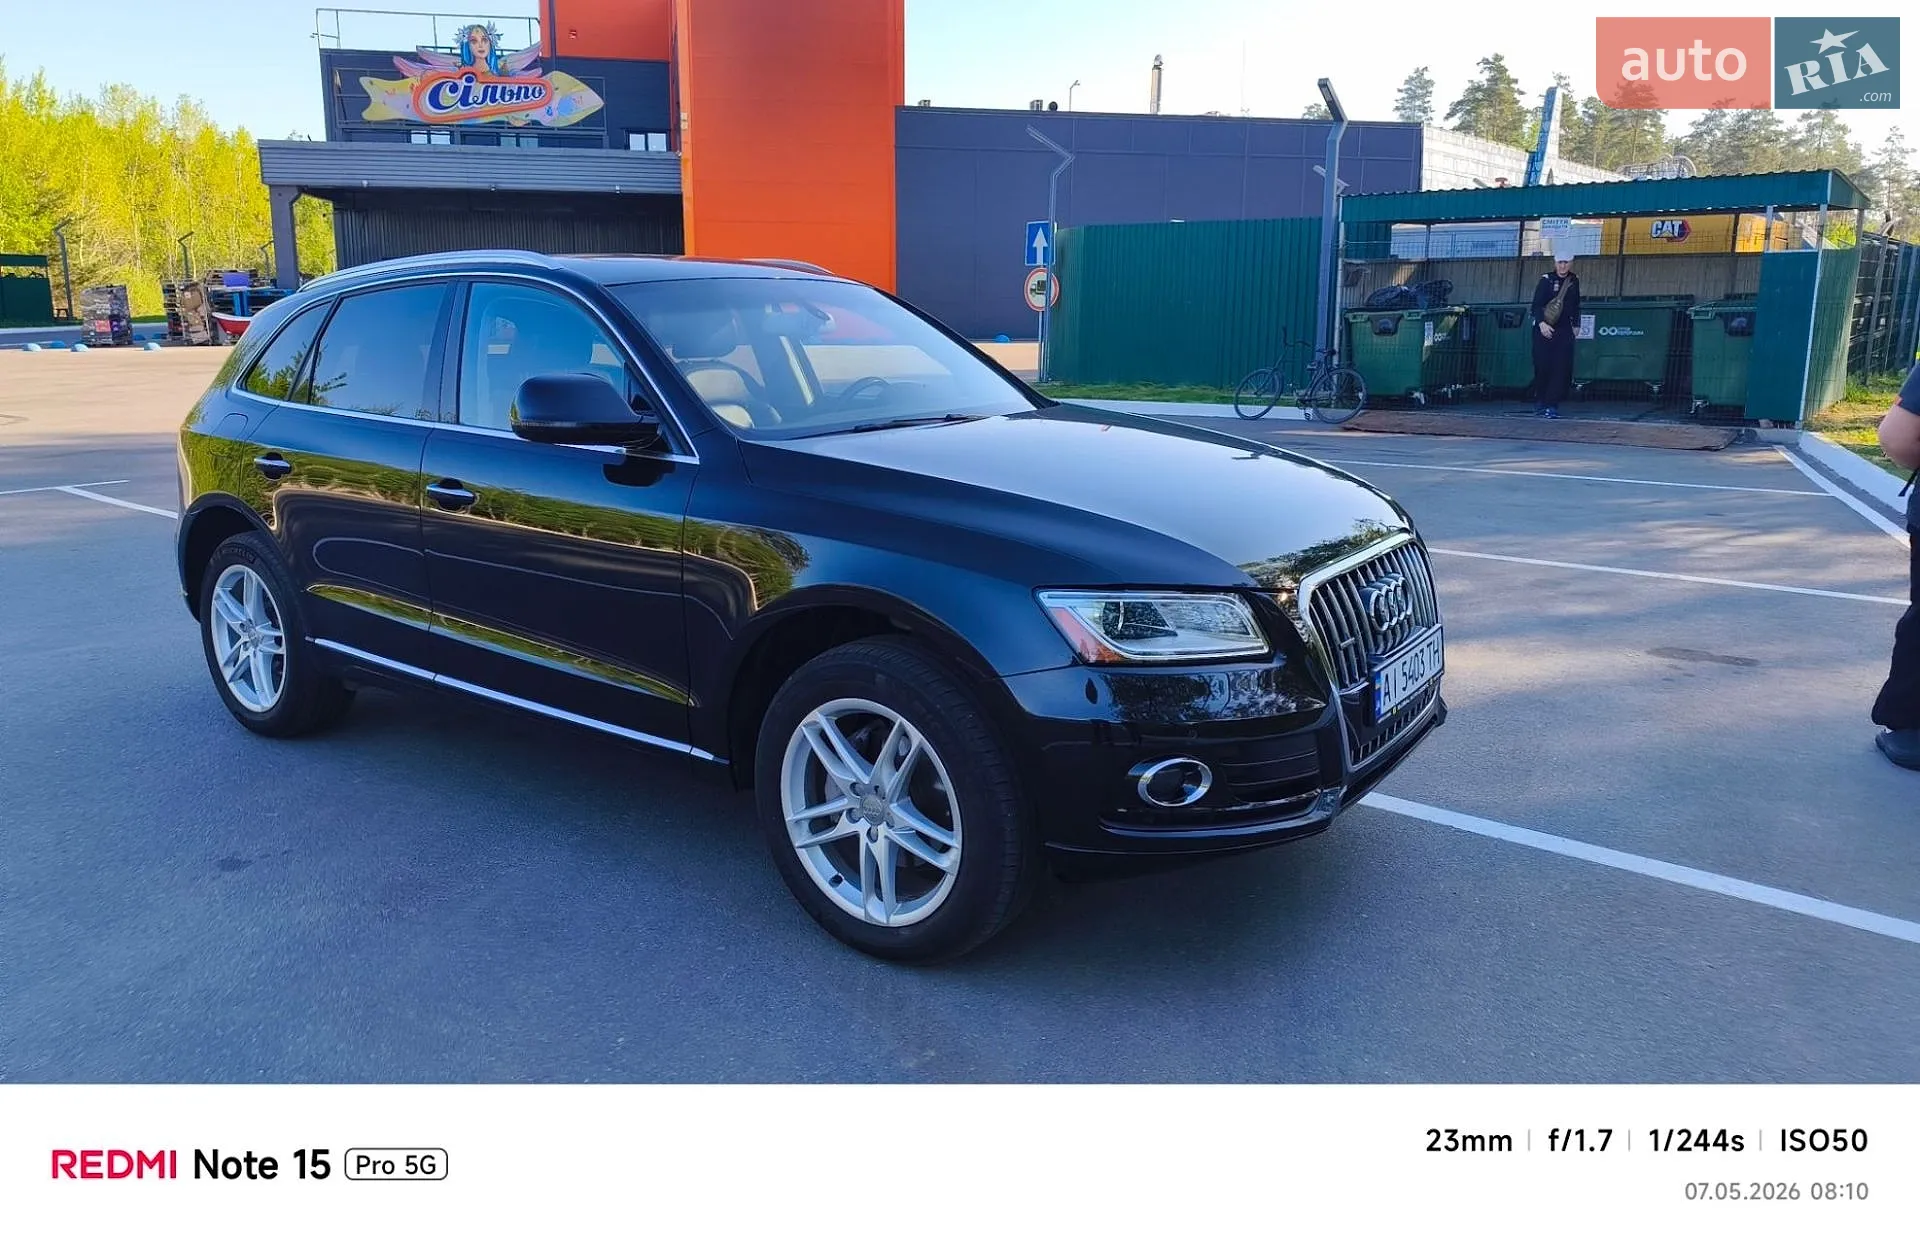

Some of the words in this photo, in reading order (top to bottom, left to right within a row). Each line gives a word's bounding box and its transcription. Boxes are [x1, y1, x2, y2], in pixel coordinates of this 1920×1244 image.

[428, 74, 544, 111] Сільпо
[1651, 220, 1683, 238] CAT
[1383, 667, 1397, 705] AI
[1401, 647, 1426, 692] 5403
[1427, 637, 1440, 670] TH
